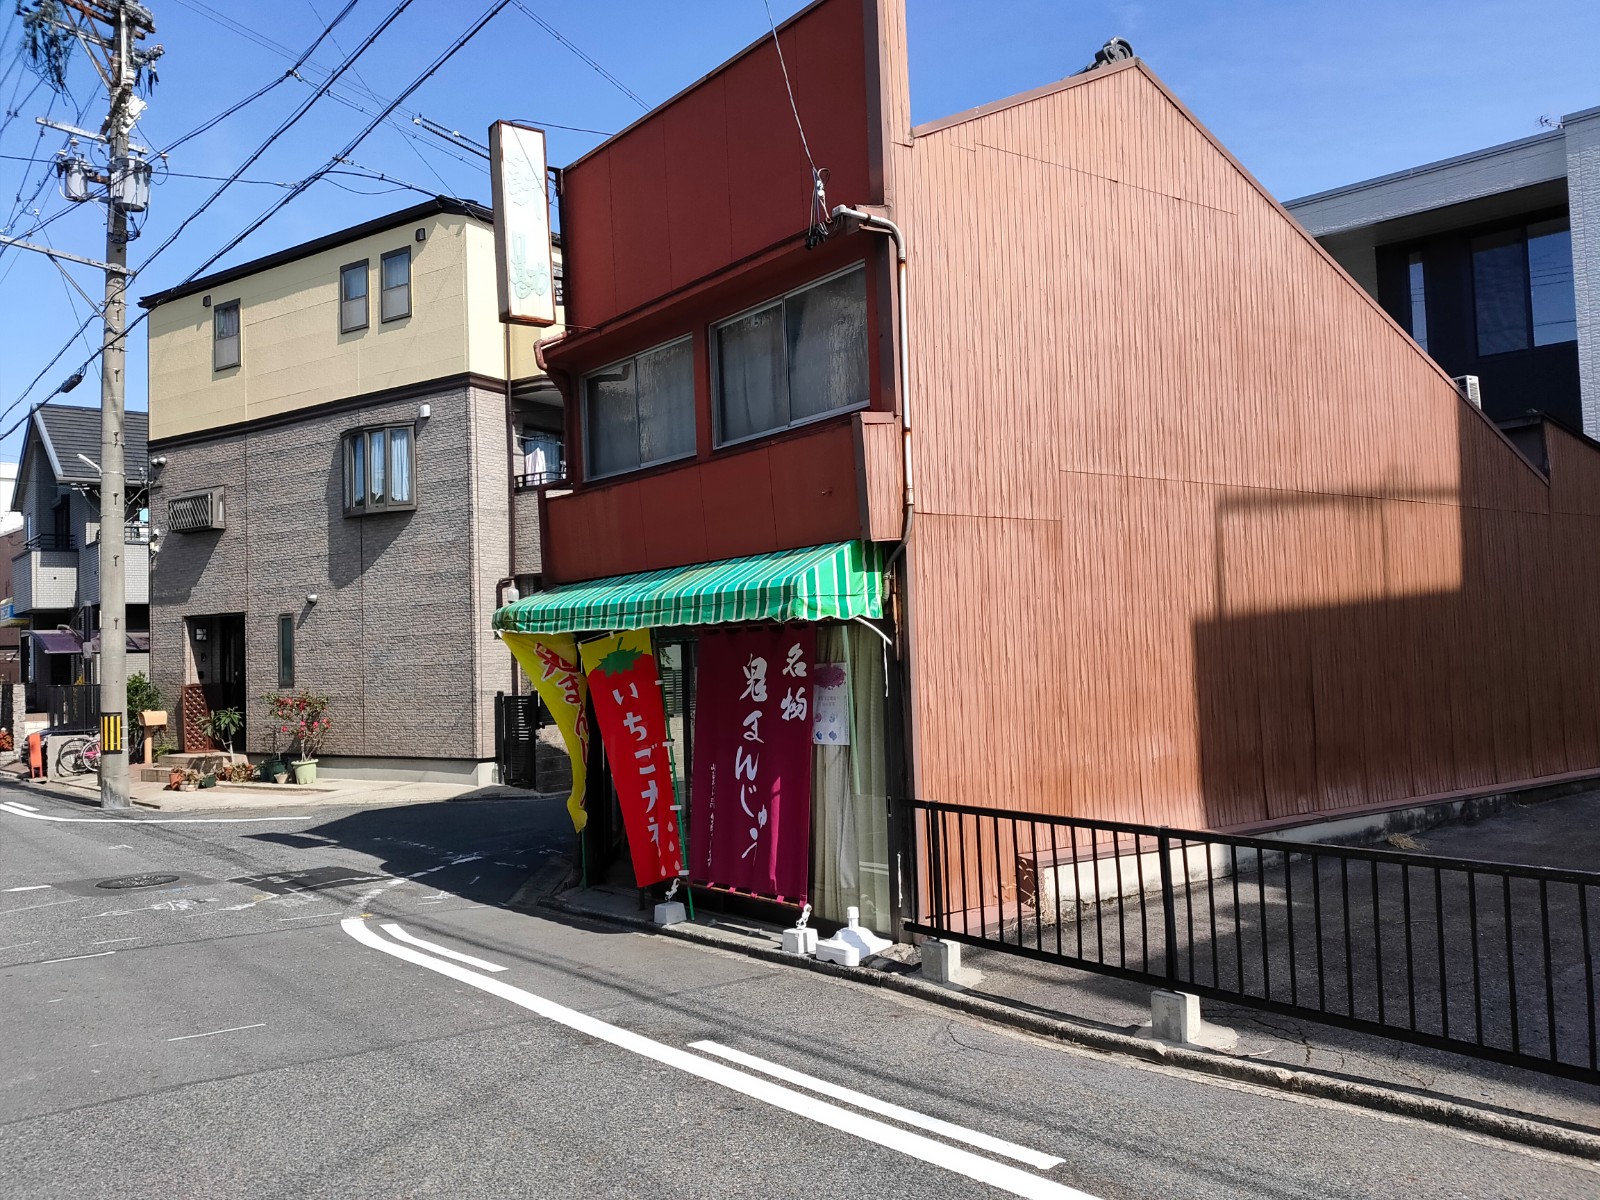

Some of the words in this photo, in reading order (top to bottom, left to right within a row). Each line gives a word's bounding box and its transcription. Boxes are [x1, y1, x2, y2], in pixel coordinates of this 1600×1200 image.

[781, 643, 808, 721] 名物
[734, 653, 768, 866] 鬼まんじゅう
